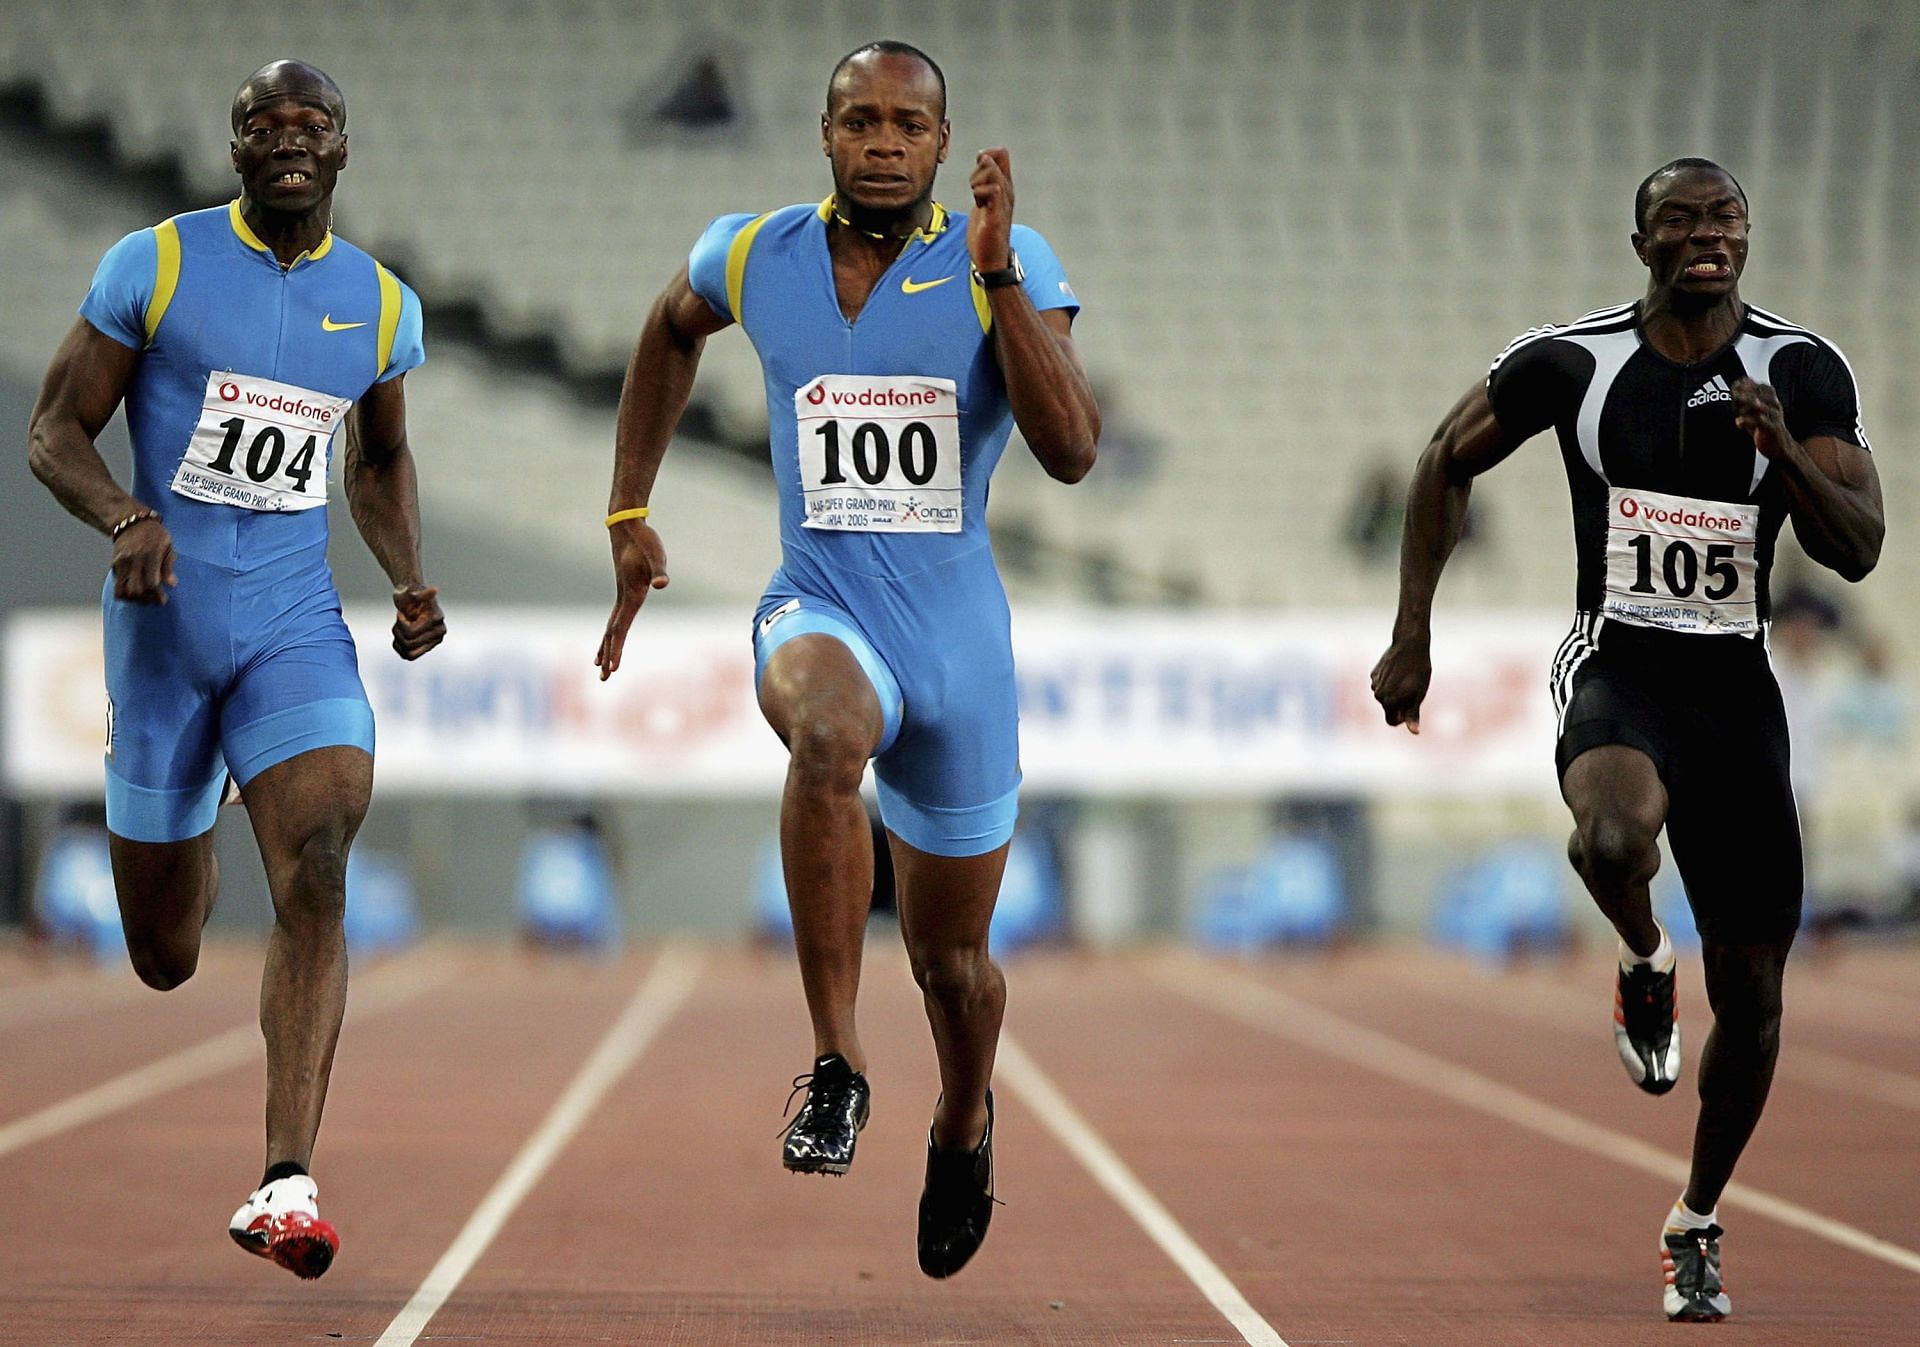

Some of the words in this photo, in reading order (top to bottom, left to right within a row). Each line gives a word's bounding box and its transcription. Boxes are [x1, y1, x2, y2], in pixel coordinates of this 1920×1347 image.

[831, 389, 937, 407] vodafone
[207, 417, 317, 493] 104
[815, 420, 938, 486] 100
[181, 471, 200, 486] IAAF
[200, 478, 225, 495] SUPER
[223, 486, 252, 504] GRAND
[251, 493, 269, 509] PRIX
[825, 497, 844, 511] PER
[845, 497, 877, 511] GRAND
[878, 498, 897, 512] PRIX
[847, 513, 869, 527] 2005
[1628, 534, 1739, 601] 105
[1628, 603, 1651, 617] SUPER
[1653, 606, 1681, 619] GRAND
[1682, 608, 1698, 620] PRIX
